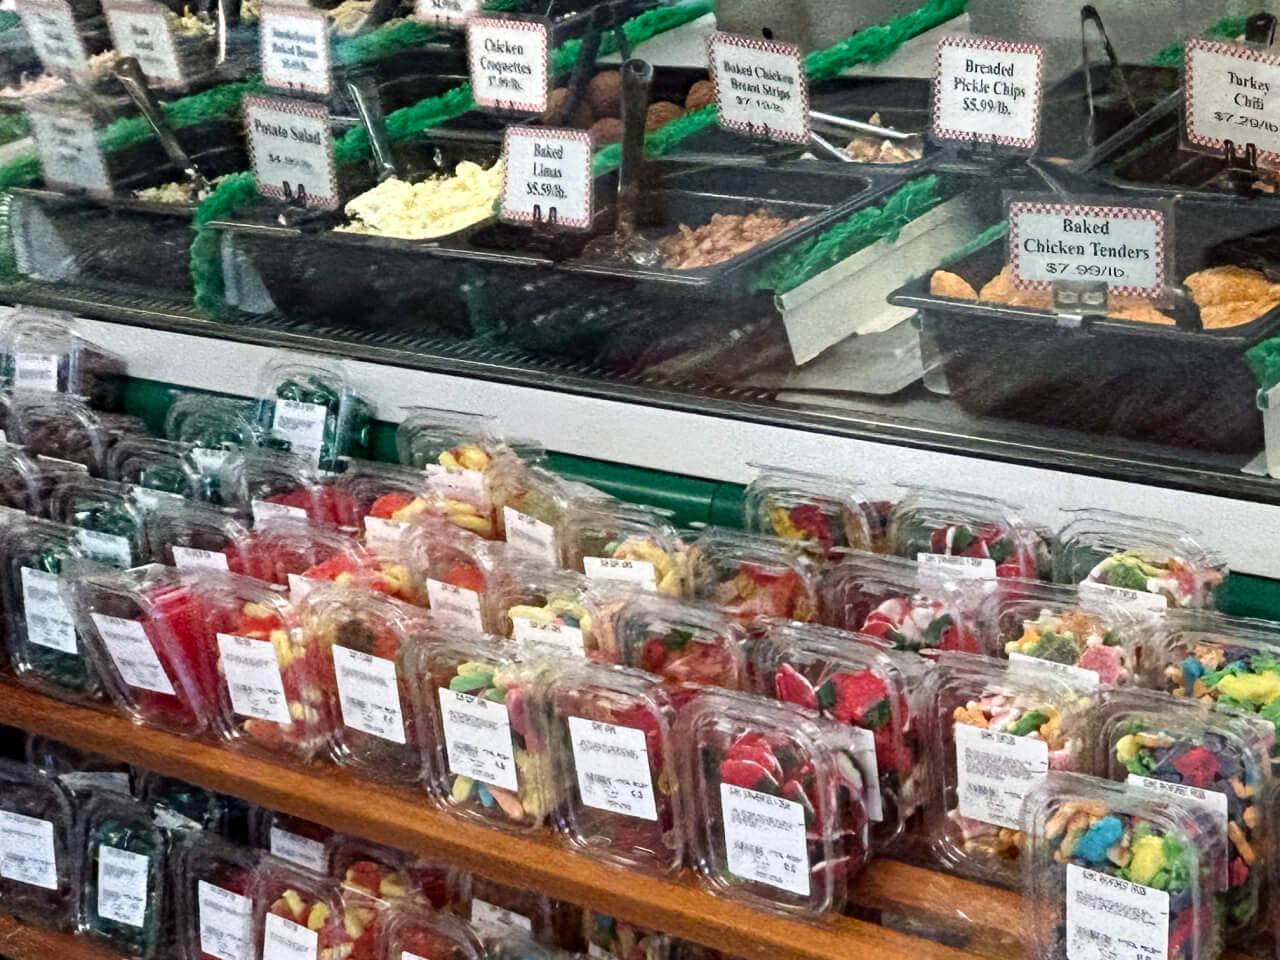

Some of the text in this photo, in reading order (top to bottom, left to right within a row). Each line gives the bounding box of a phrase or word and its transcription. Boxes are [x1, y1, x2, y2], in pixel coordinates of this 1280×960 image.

[723, 60, 794, 85] Baked Chicken
[965, 58, 1014, 77] Breaded
[730, 77, 791, 101] Breast Strips
[953, 76, 1026, 101] Pickle Chips
[1227, 71, 1270, 96] Turkey
[1233, 92, 1264, 110] Chili
[254, 118, 321, 145] Potato Salad
[533, 143, 564, 160] Baked
[533, 162, 562, 178] Limas
[1063, 218, 1110, 235] Baked
[1024, 238, 1150, 260] Chicken Tenders
